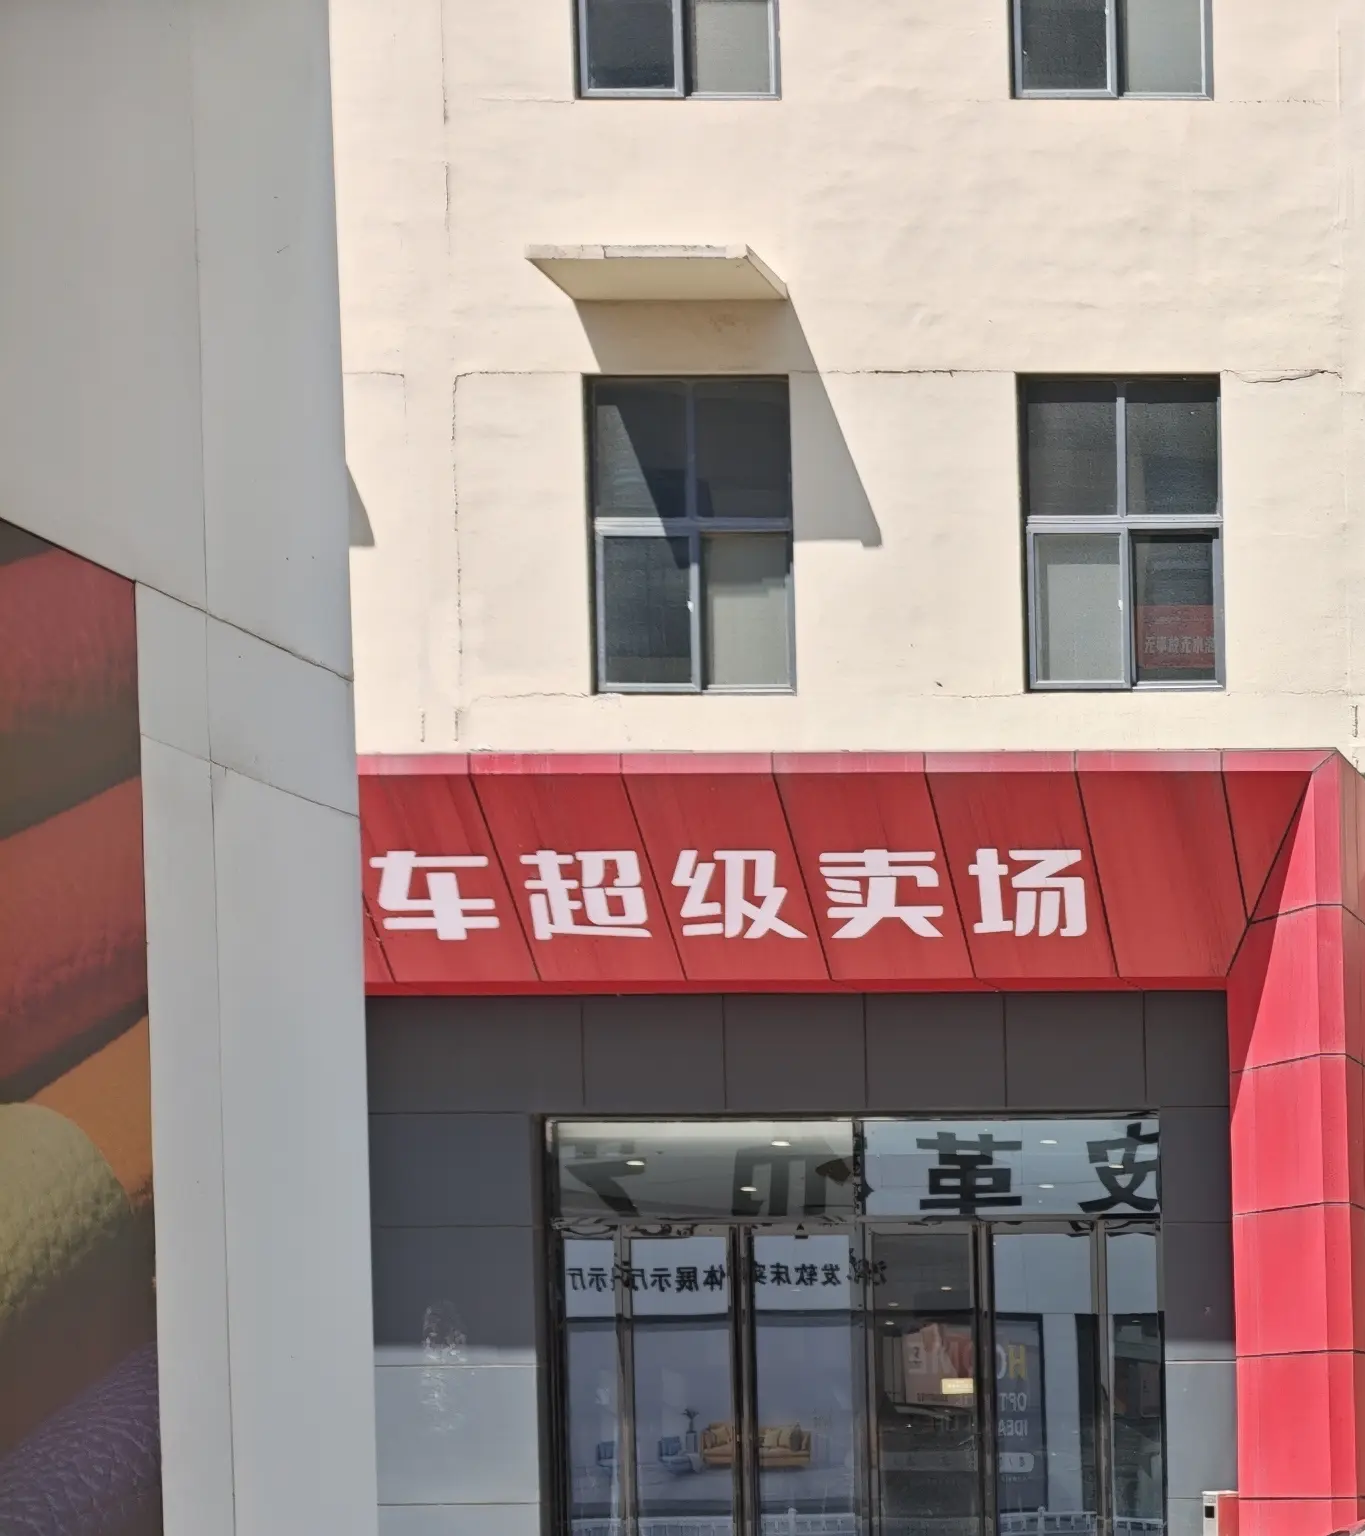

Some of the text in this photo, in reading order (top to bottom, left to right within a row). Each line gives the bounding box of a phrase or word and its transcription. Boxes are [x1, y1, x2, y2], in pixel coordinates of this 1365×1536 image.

[369, 847, 1089, 941] 车超级卖场
